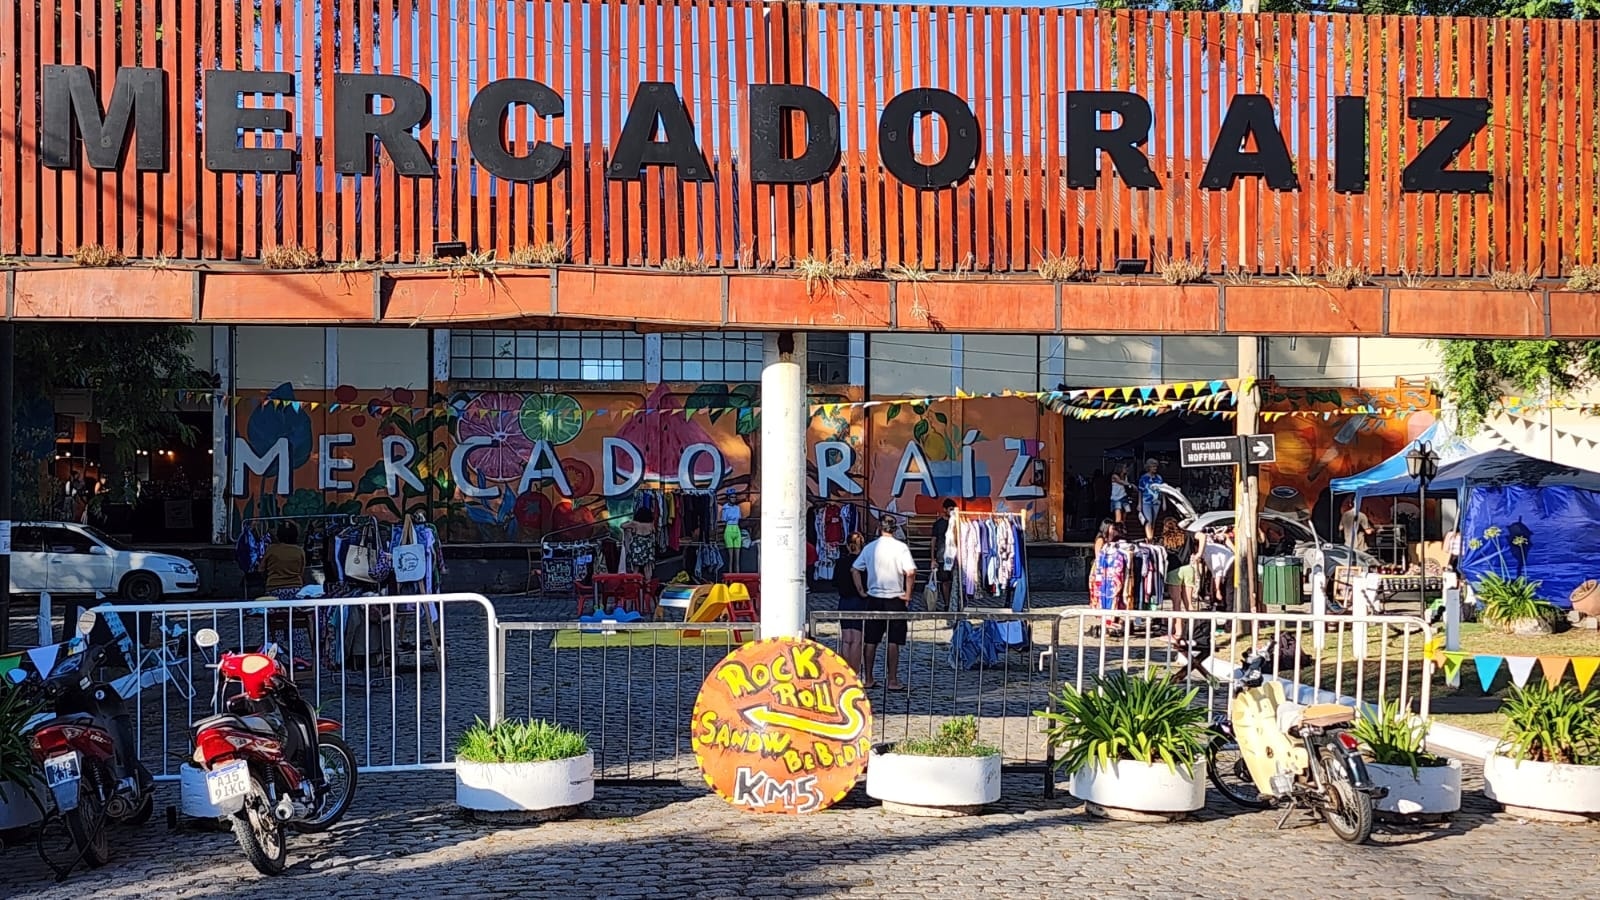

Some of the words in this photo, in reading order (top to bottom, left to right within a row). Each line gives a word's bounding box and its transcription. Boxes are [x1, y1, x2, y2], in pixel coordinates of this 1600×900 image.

[42, 64, 981, 191] MERCADO
[1066, 90, 1492, 193] RAIZ
[232, 433, 724, 498] MERCADO
[815, 429, 1046, 499] RAÍZ
[1187, 452, 1232, 462] HOFFMANN
[1191, 441, 1227, 451] RICARDO
[715, 645, 821, 698] ROCK
[699, 711, 791, 753] SANDW
[217, 771, 239, 788] A15
